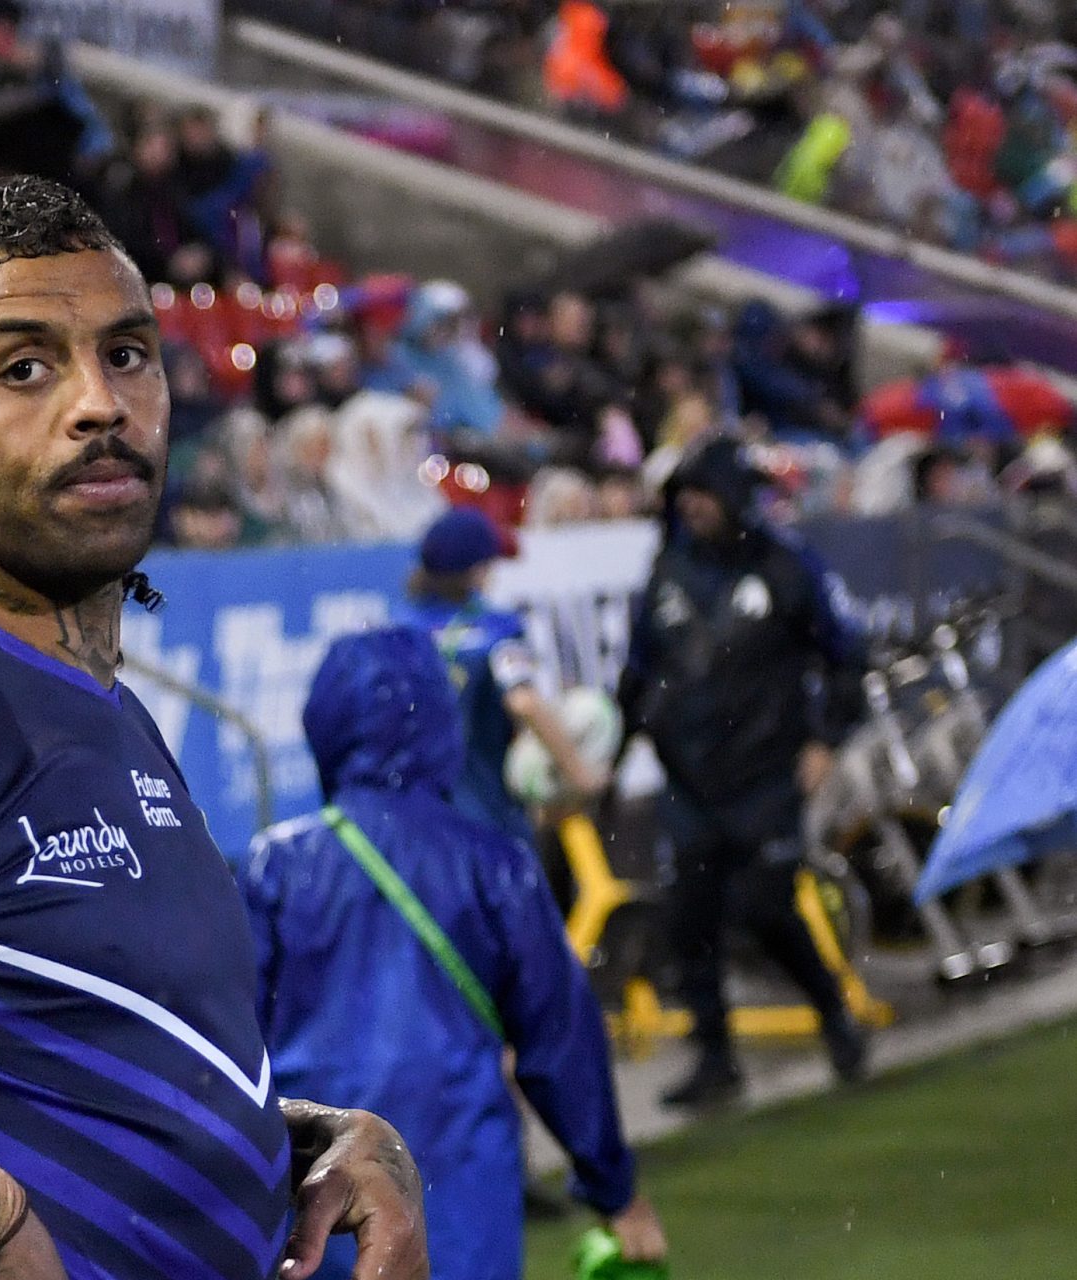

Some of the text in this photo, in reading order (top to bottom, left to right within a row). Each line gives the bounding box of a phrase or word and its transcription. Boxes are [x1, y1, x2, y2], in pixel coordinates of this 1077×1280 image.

[130, 769, 171, 798] Future
[16, 808, 142, 887] Laundy
[60, 853, 126, 874] HOTELS
